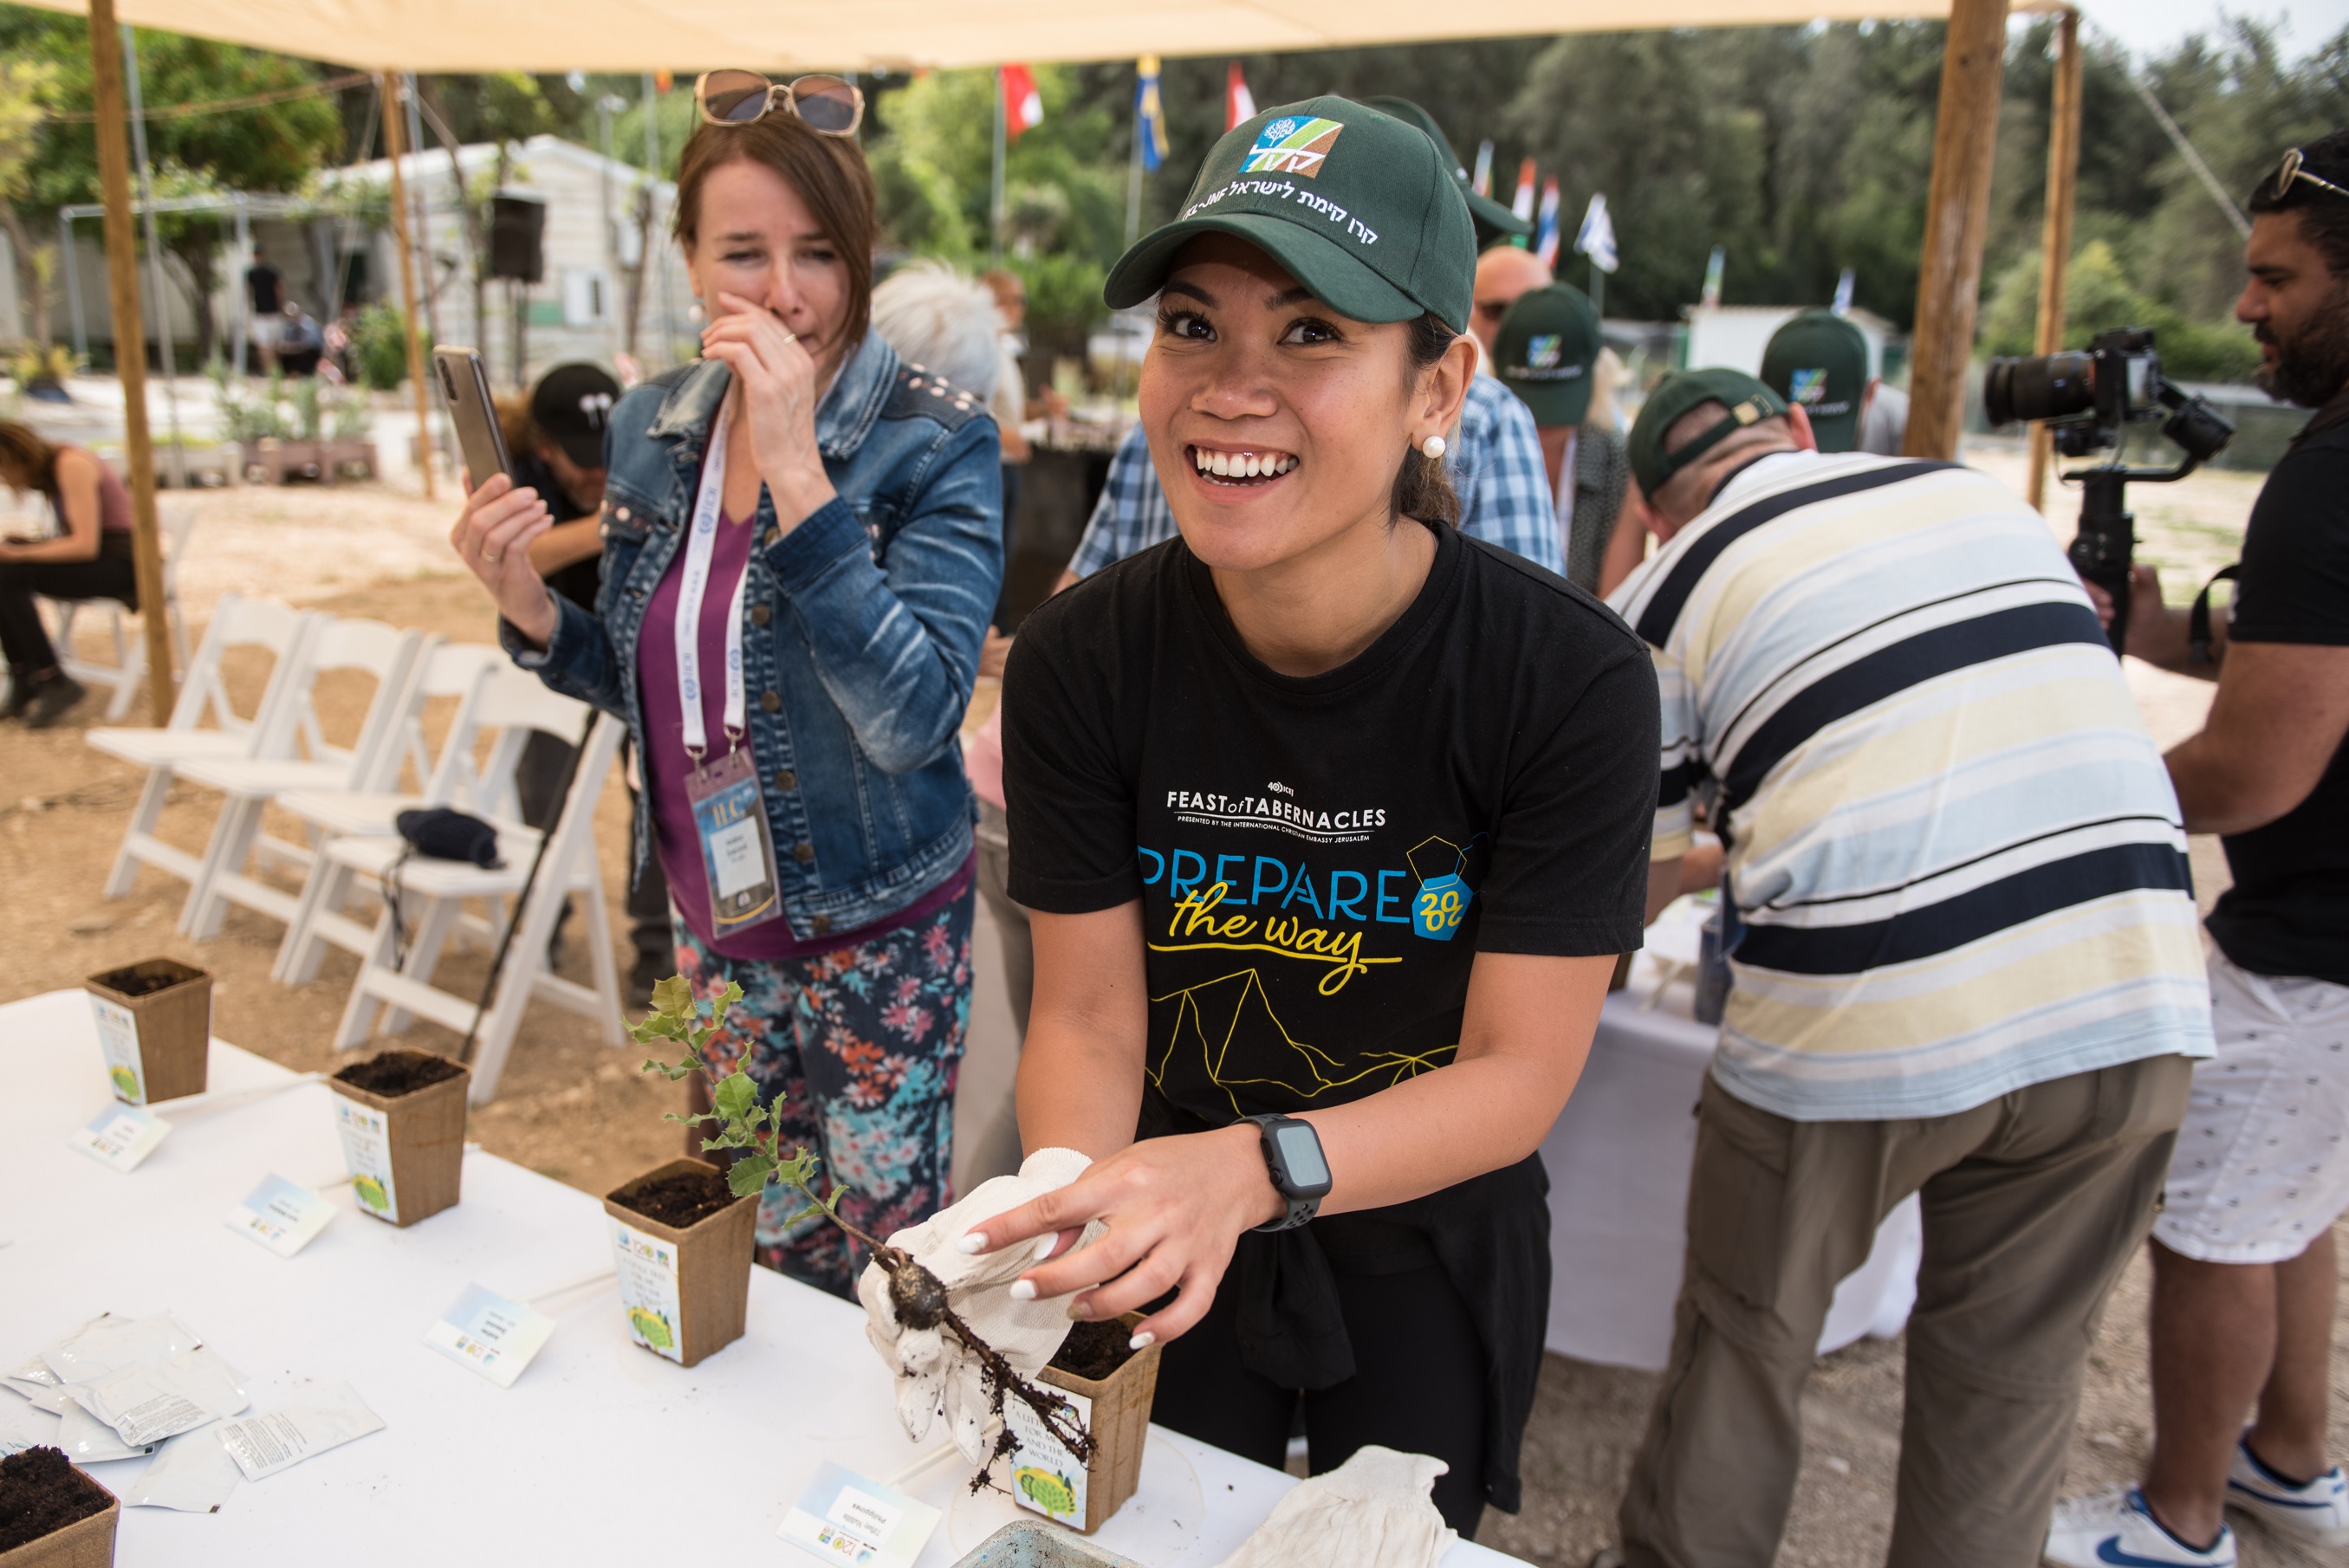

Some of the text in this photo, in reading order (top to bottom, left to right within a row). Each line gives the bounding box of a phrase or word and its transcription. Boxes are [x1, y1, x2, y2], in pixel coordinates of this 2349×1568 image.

[1228, 180, 1379, 245] קרן קימת לישראל
[1166, 790, 1386, 830] FEAST of TABERNACLES
[1178, 815, 1210, 826] PRESENTED
[1233, 821, 1281, 832] INTERNATIONAL
[1281, 826, 1306, 839] CHRISTIAN
[1306, 834, 1333, 844] EMBASSY
[1334, 834, 1370, 844] JERUSALEM
[1138, 845, 1411, 923] PREPARE
[1169, 881, 1367, 995] the way
[1024, 1425, 1042, 1438] FOR
[1026, 1437, 1065, 1458] AND THE
[1028, 1448, 1064, 1468] WORLD
